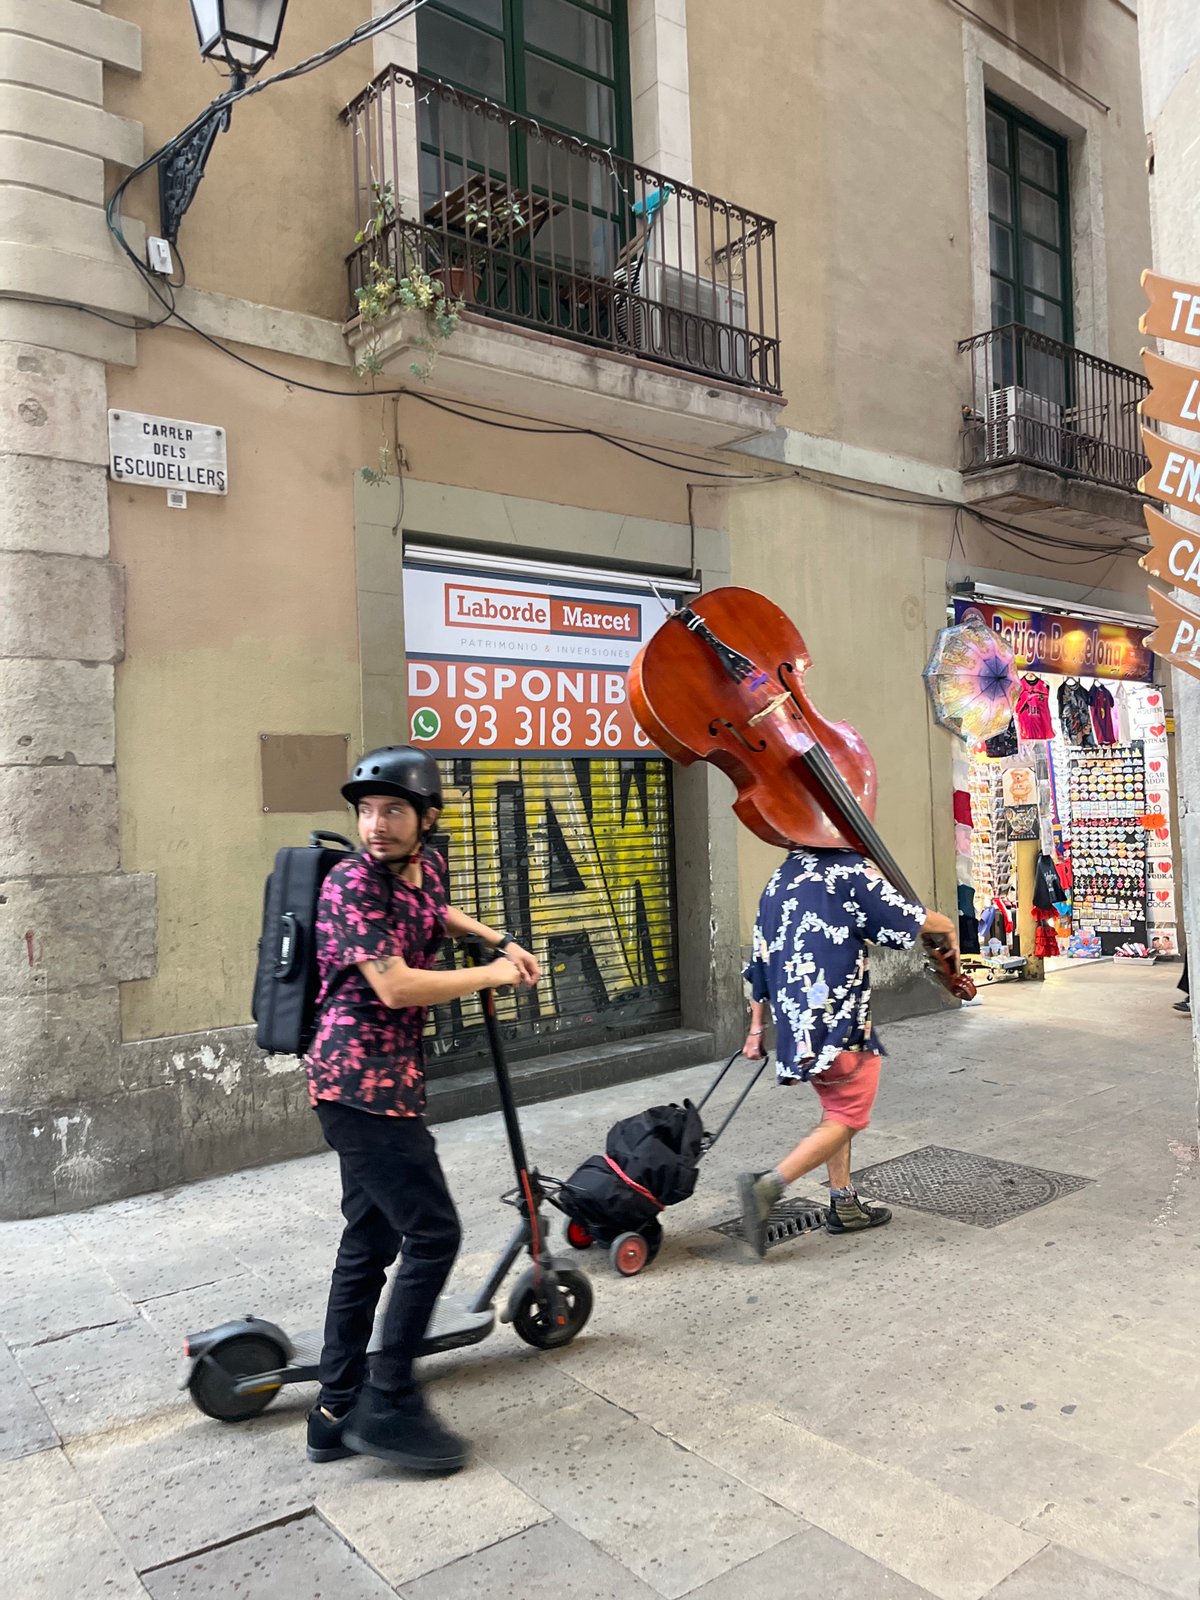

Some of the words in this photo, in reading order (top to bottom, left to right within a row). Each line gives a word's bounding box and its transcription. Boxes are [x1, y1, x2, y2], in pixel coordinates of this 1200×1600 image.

[1180, 379, 1200, 422] L
[143, 422, 193, 441] CARRER
[153, 442, 187, 459] DELS
[113, 455, 225, 487] ESCUDELLERS
[1158, 451, 1200, 505] EN
[457, 595, 547, 624] Laborde
[562, 605, 631, 632] Marcet
[460, 638, 538, 653] PATRIMONIO
[544, 644, 551, 653] &
[557, 646, 631, 659] INVERSIONES
[1050, 622, 1123, 668] Baelona
[454, 704, 498, 747] 93
[514, 705, 572, 748] 318
[585, 708, 623, 748] 36
[633, 720, 655, 747] 6
[1147, 891, 1155, 901] I
